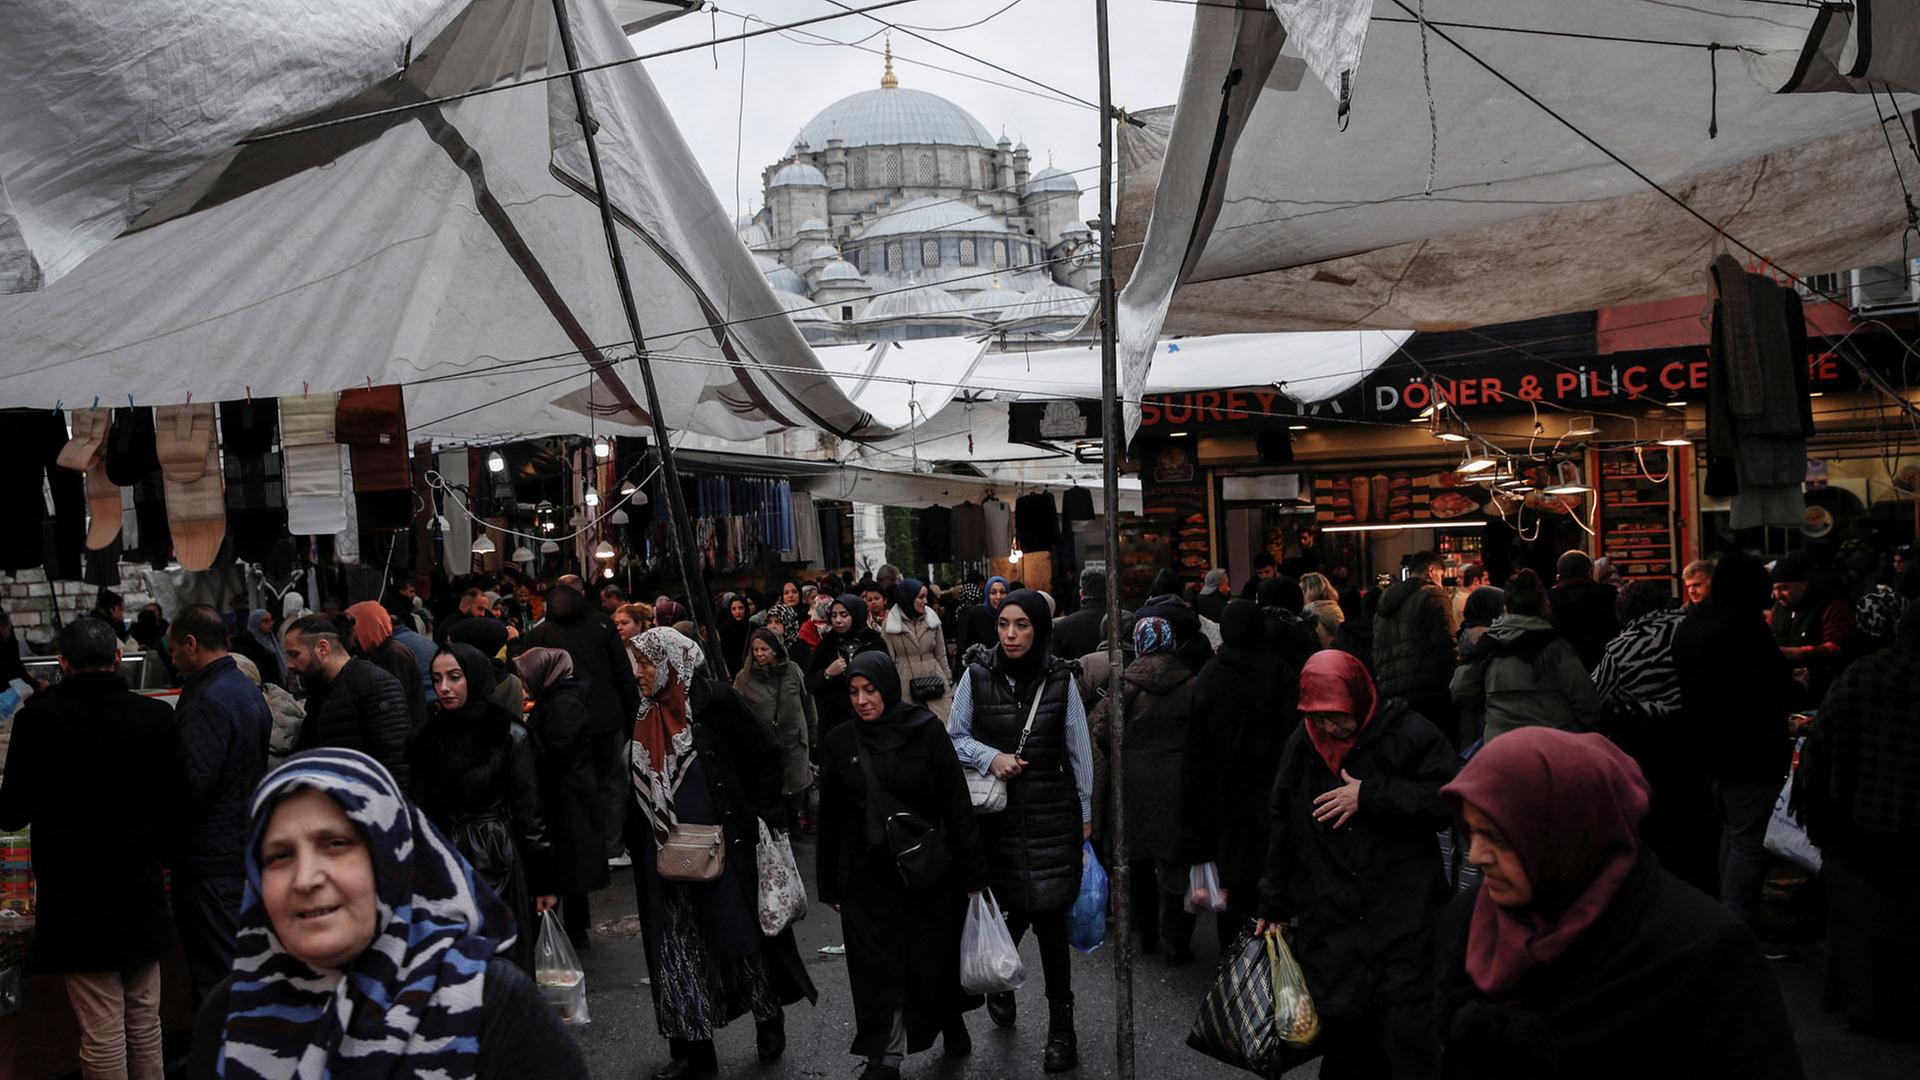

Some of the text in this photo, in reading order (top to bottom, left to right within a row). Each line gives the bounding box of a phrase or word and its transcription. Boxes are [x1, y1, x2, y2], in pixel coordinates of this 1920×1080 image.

[1375, 376, 1505, 412] DÖNER
[1517, 373, 1545, 402] &
[1555, 361, 1650, 401] PİLİÇ
